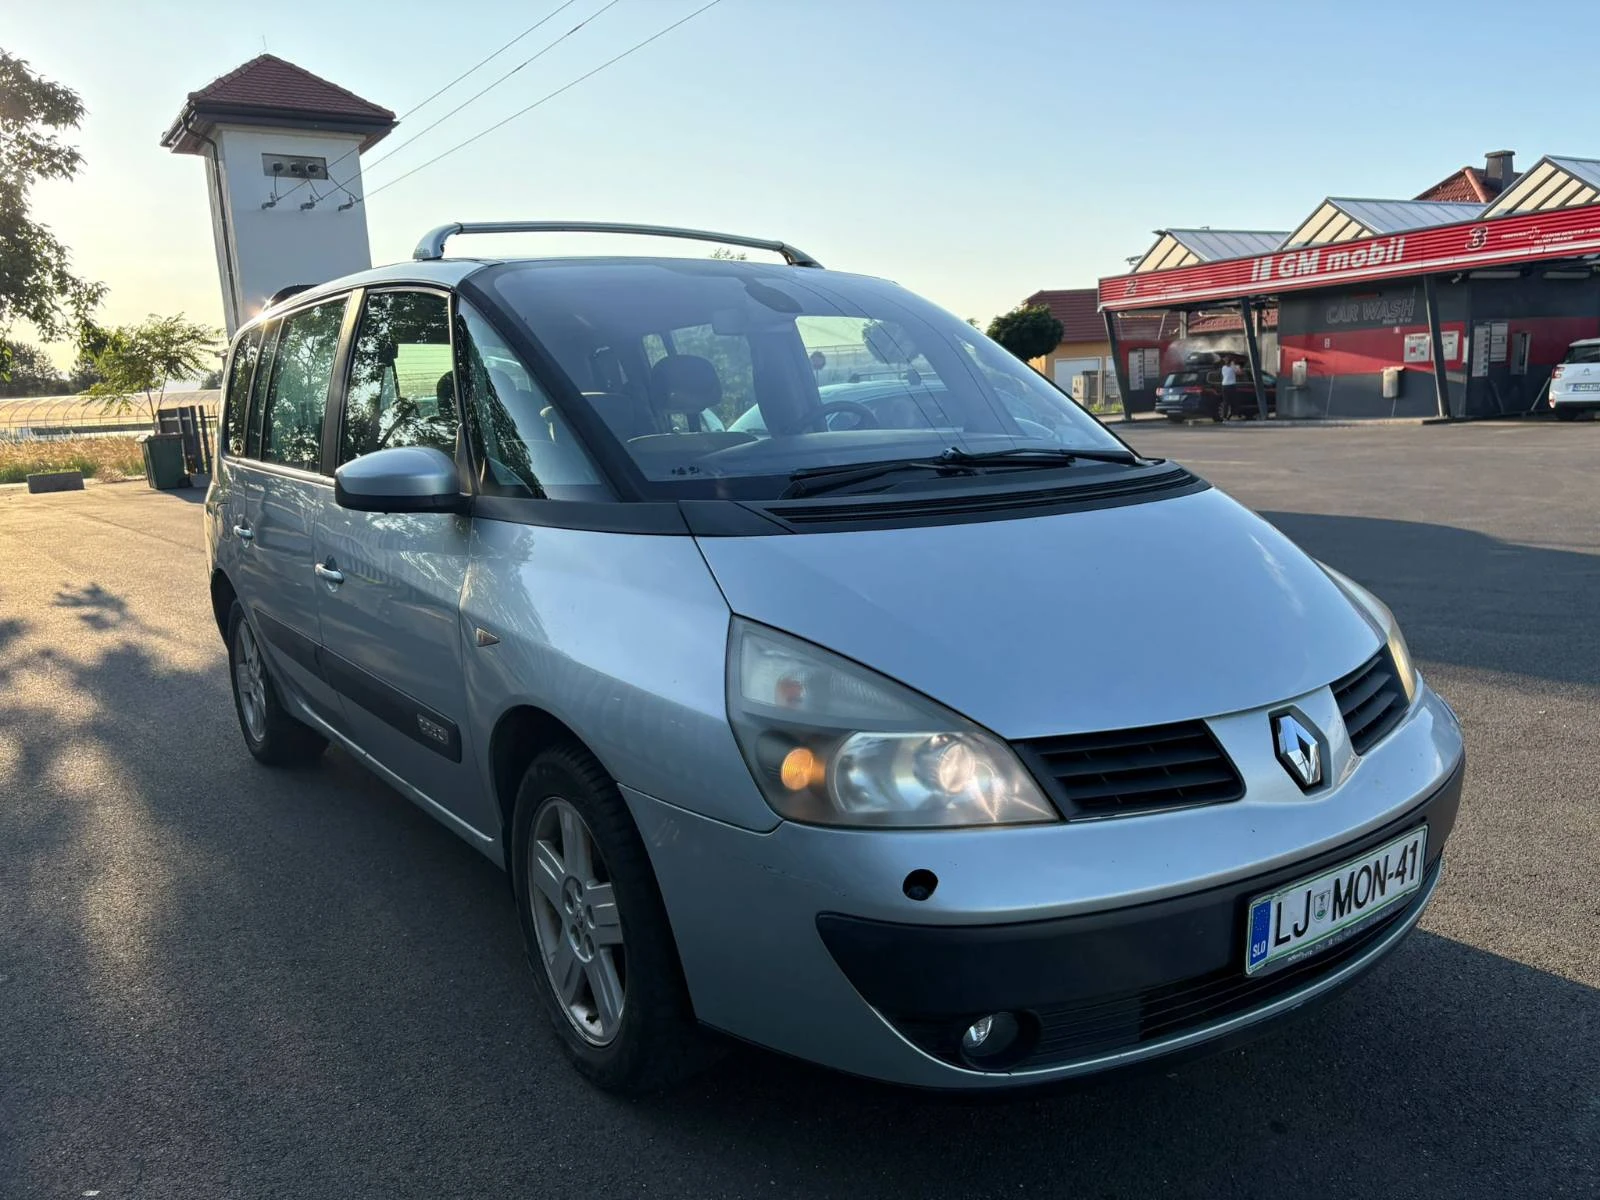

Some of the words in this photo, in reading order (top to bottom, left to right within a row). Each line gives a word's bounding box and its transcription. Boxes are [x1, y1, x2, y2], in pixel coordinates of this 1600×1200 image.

[1464, 226, 1489, 251] 3
[1278, 249, 1321, 278] GM
[1325, 237, 1406, 272] mobil
[1122, 279, 1138, 297] 2
[1325, 303, 1359, 325] CAR
[1362, 291, 1416, 321] WASH
[1273, 889, 1312, 947] LJ
[1331, 839, 1419, 922] MON-41
[1252, 939, 1267, 959] SLO
